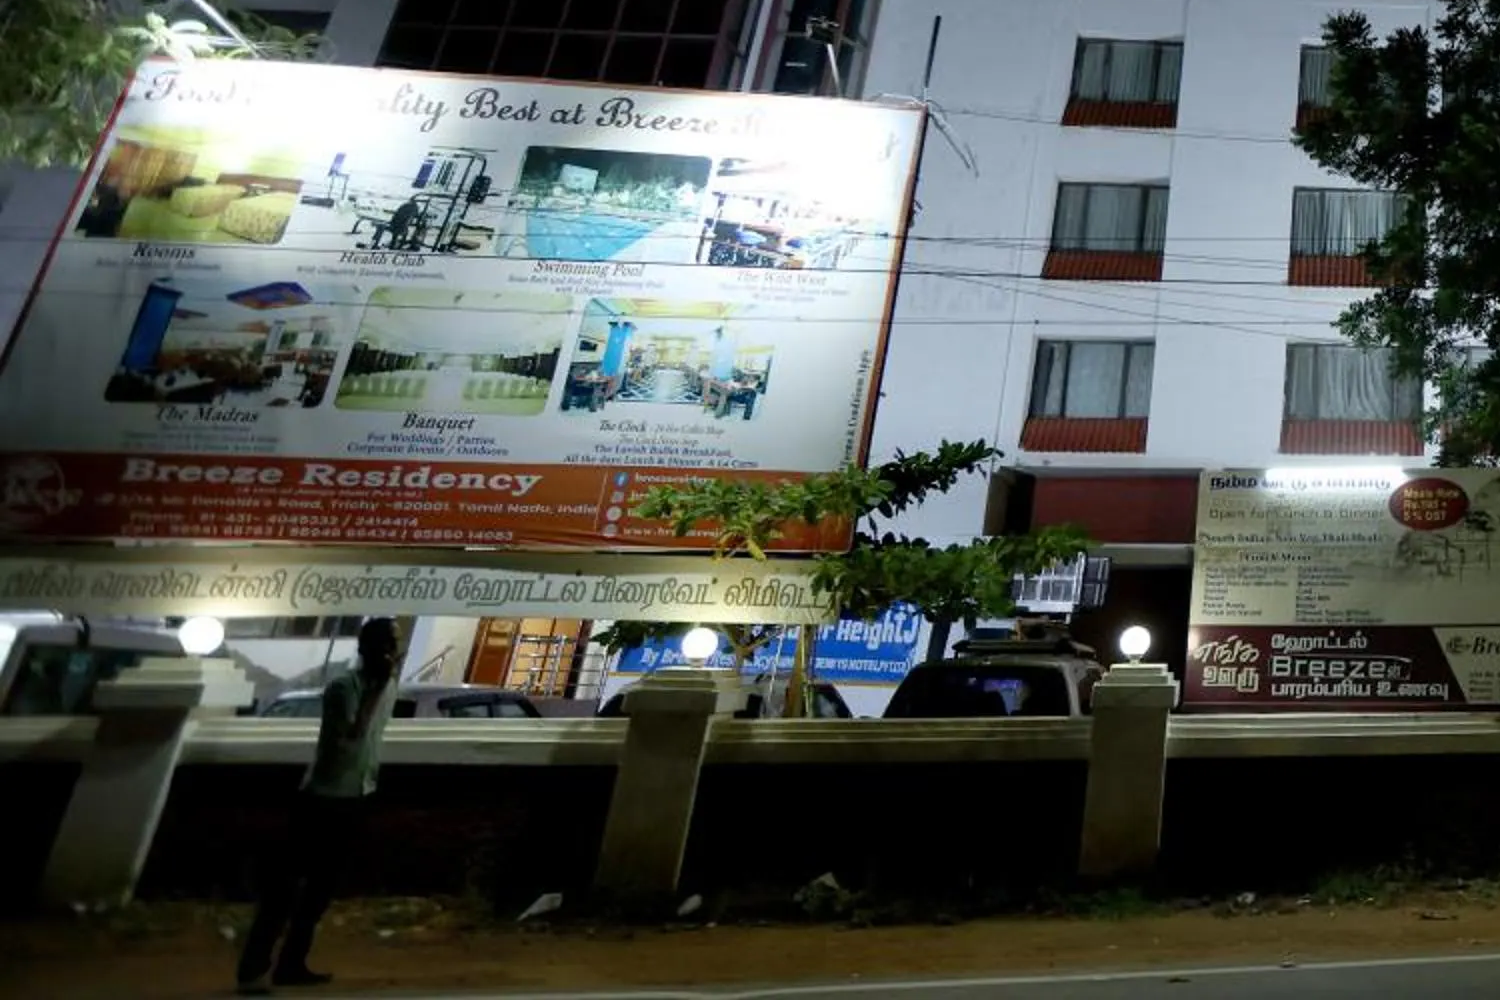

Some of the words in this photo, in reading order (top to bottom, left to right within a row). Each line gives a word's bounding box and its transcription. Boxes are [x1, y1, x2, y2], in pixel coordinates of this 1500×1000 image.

[460, 87, 539, 123] Best
[549, 100, 586, 126] at
[595, 96, 720, 136] Breeze
[339, 250, 388, 266] Health
[391, 252, 425, 267] Club
[533, 260, 611, 278] Swimming
[612, 262, 646, 277] Pool
[157, 405, 189, 421] The
[192, 405, 259, 423] Madras
[402, 413, 476, 435] Banquet
[121, 457, 285, 486] Breeze
[300, 462, 544, 497] Residency
